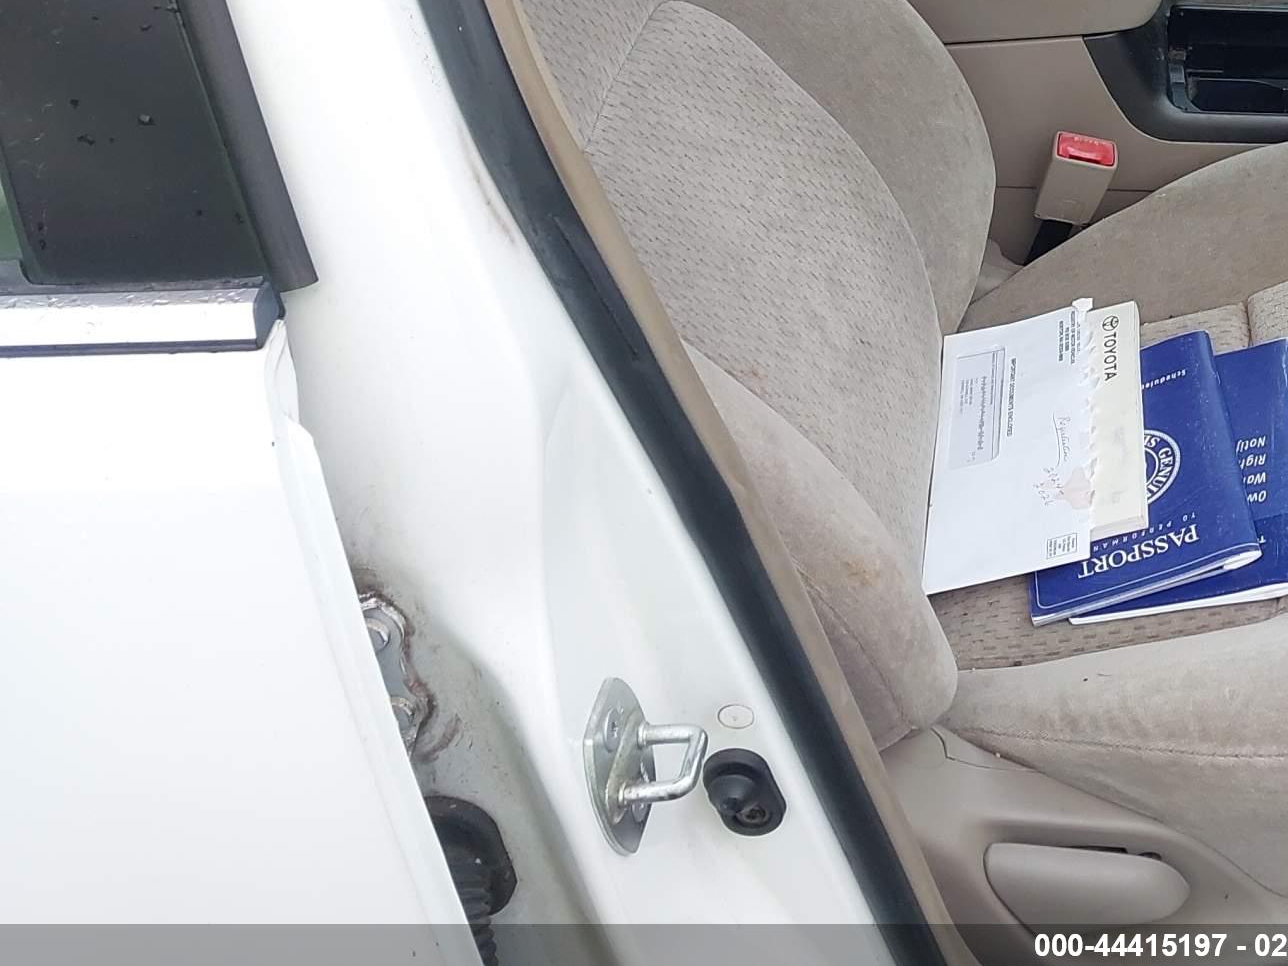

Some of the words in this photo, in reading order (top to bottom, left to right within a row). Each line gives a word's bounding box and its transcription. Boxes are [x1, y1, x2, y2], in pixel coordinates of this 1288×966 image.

[1104, 331, 1117, 382] TOYOTA
[1146, 447, 1173, 497] GENUI
[1078, 524, 1200, 579] PASSPORT
